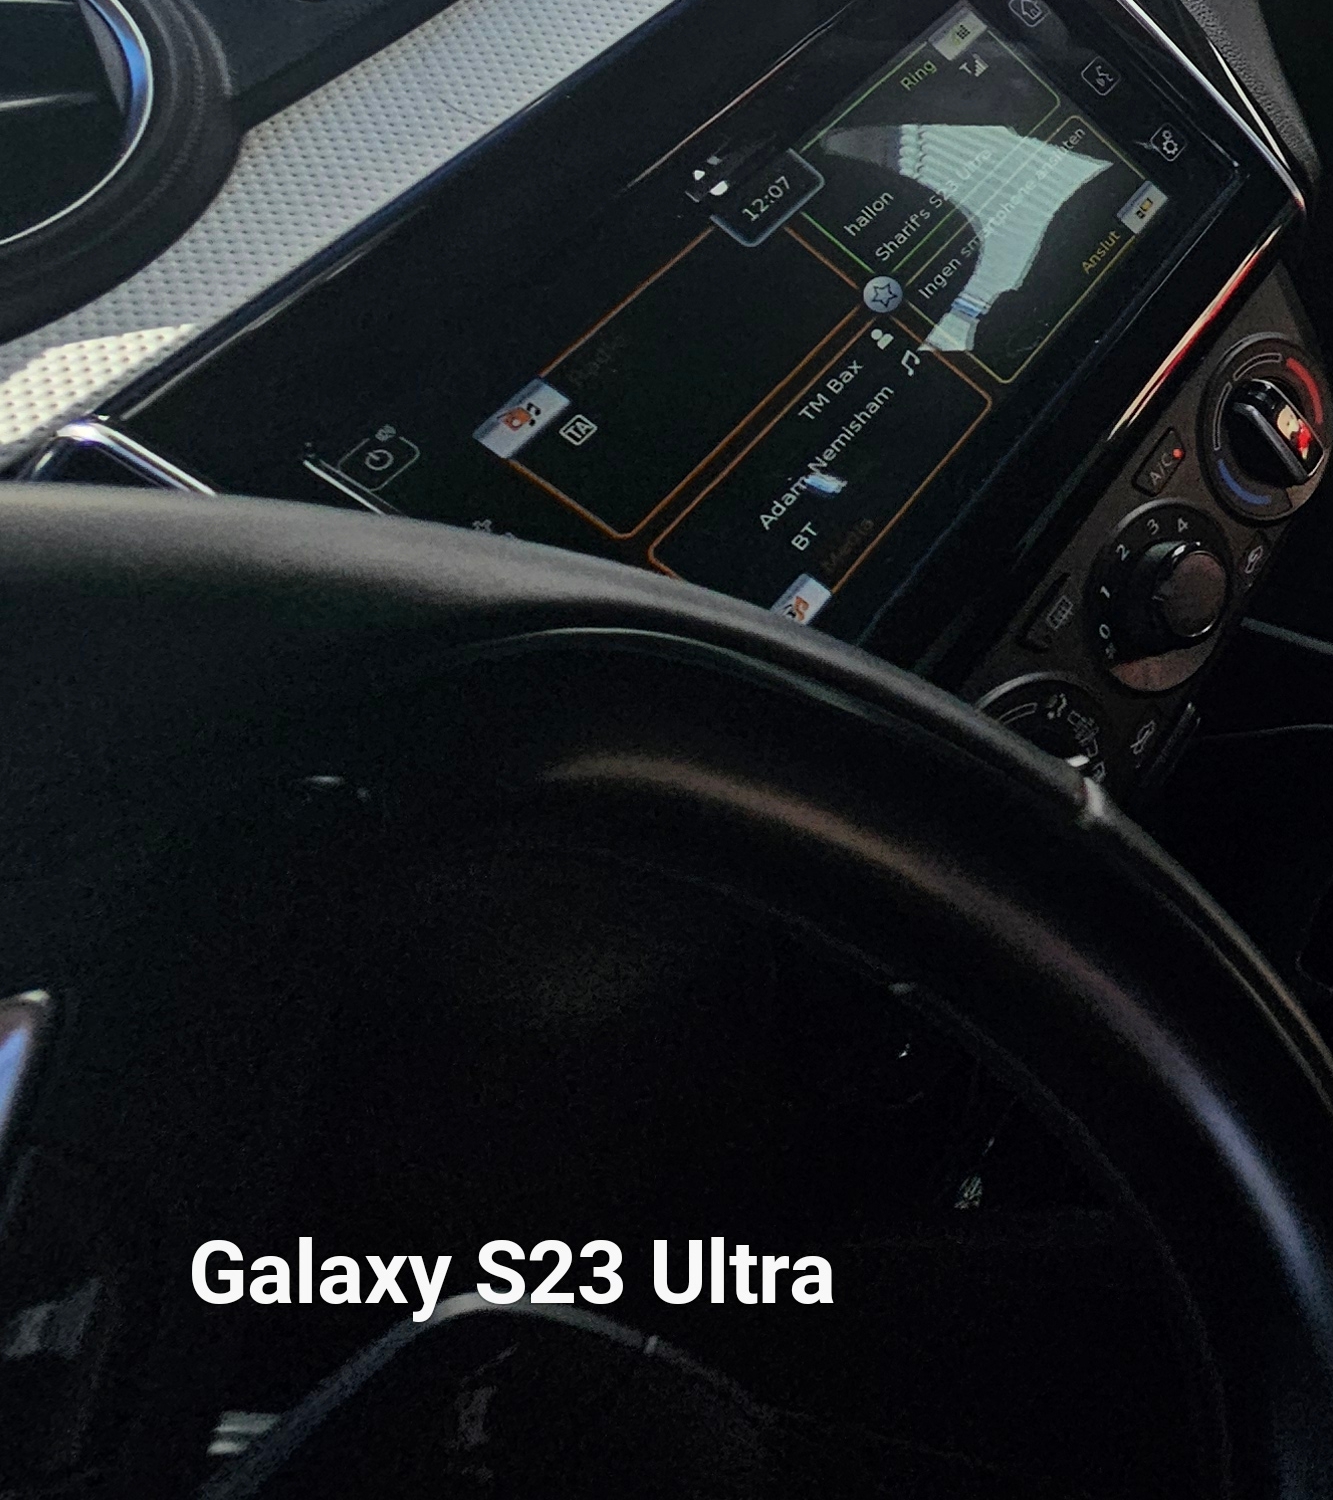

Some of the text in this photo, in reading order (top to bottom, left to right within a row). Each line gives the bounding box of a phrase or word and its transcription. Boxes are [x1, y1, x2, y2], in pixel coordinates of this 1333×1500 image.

[899, 57, 938, 93] Ring
[741, 175, 791, 222] 12:07
[843, 191, 895, 237] hallon
[874, 208, 931, 262] Sharif's
[928, 179, 960, 209] S23
[1081, 229, 1122, 275] Anslut
[918, 256, 962, 300] Ingen
[798, 359, 865, 421] TM Bax
[564, 420, 591, 440] TA
[806, 385, 896, 476] Nemisham
[1149, 453, 1174, 486] A/C
[790, 521, 820, 551] BT
[1146, 518, 1161, 536] 3
[1176, 517, 1190, 534] 4
[1115, 543, 1132, 562] 2
